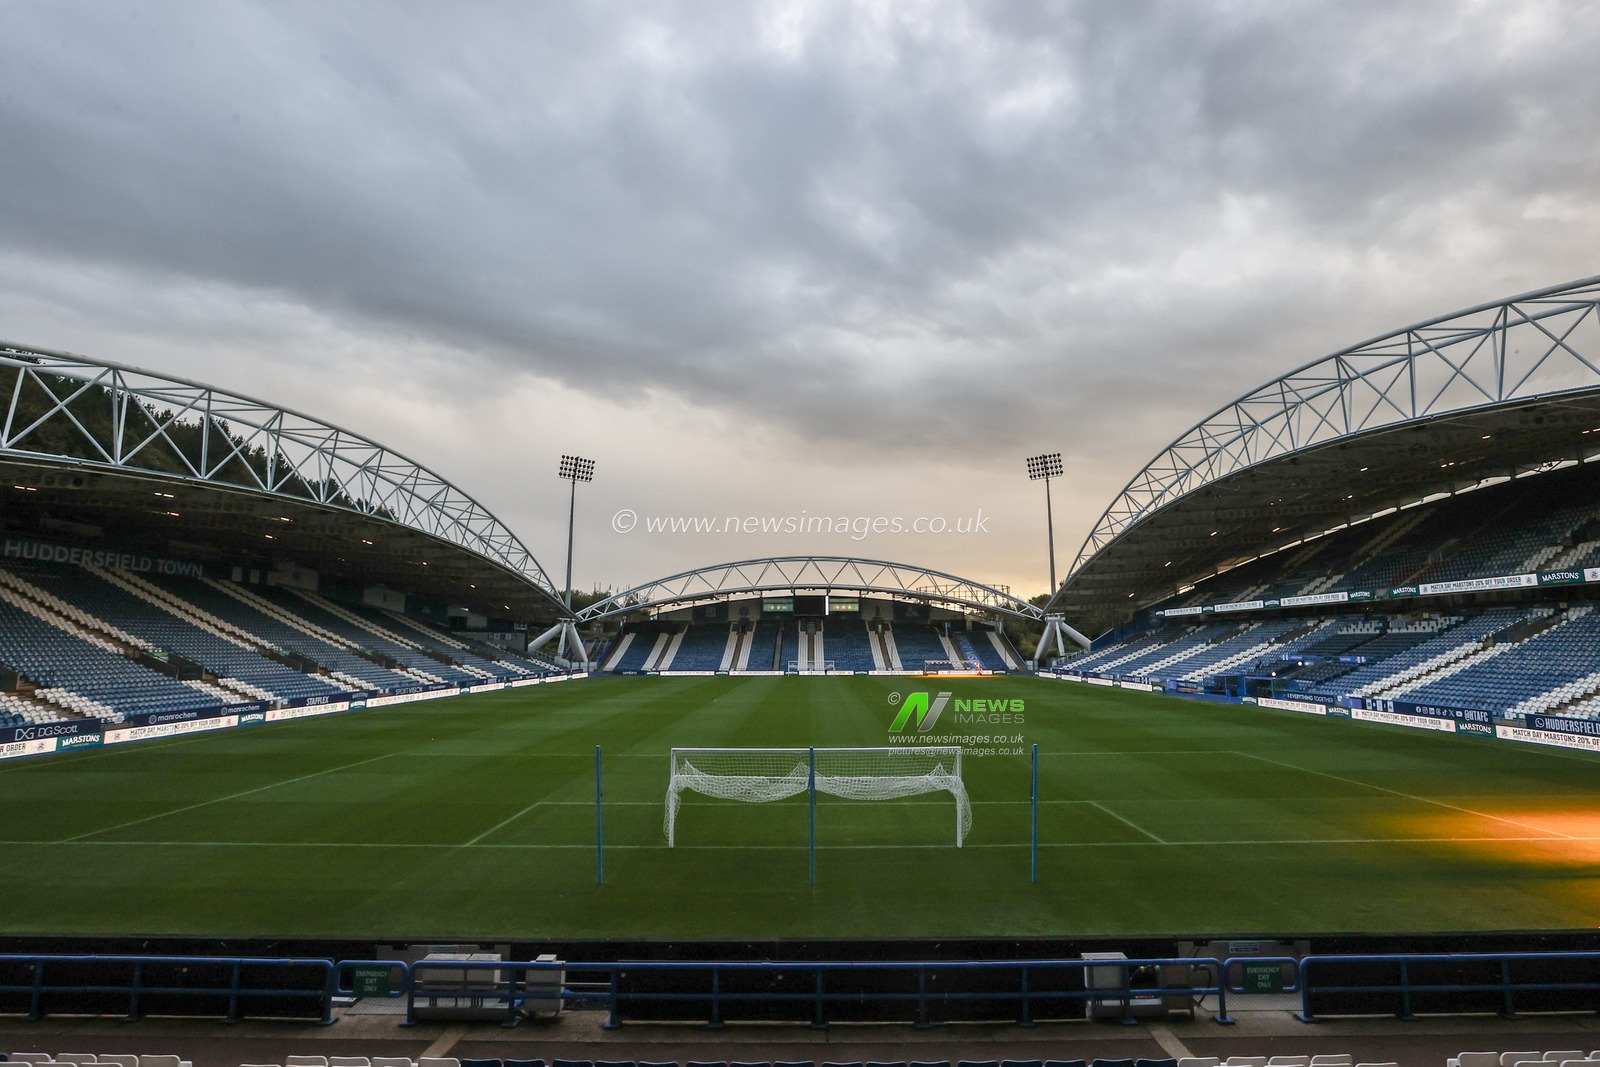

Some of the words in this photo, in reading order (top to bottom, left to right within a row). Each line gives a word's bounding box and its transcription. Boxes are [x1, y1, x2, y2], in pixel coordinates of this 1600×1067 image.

[4, 540, 151, 572] HUDDERSFIELD
[157, 558, 204, 578] TOWN
[1542, 572, 1579, 582] MARSTONS
[1392, 586, 1416, 594] MARSTONS
[228, 705, 260, 713] manrochem
[157, 712, 197, 722] manrochem
[1464, 710, 1489, 722] @HTAFC
[1459, 724, 1492, 734] MARSTONS
[1545, 718, 1600, 734] HUDDERSFIELD
[1512, 729, 1531, 737] MATCH
[1544, 733, 1576, 742] MARSTONS
[62, 735, 100, 747] MARSTONS
[6, 743, 26, 751] ORDER
